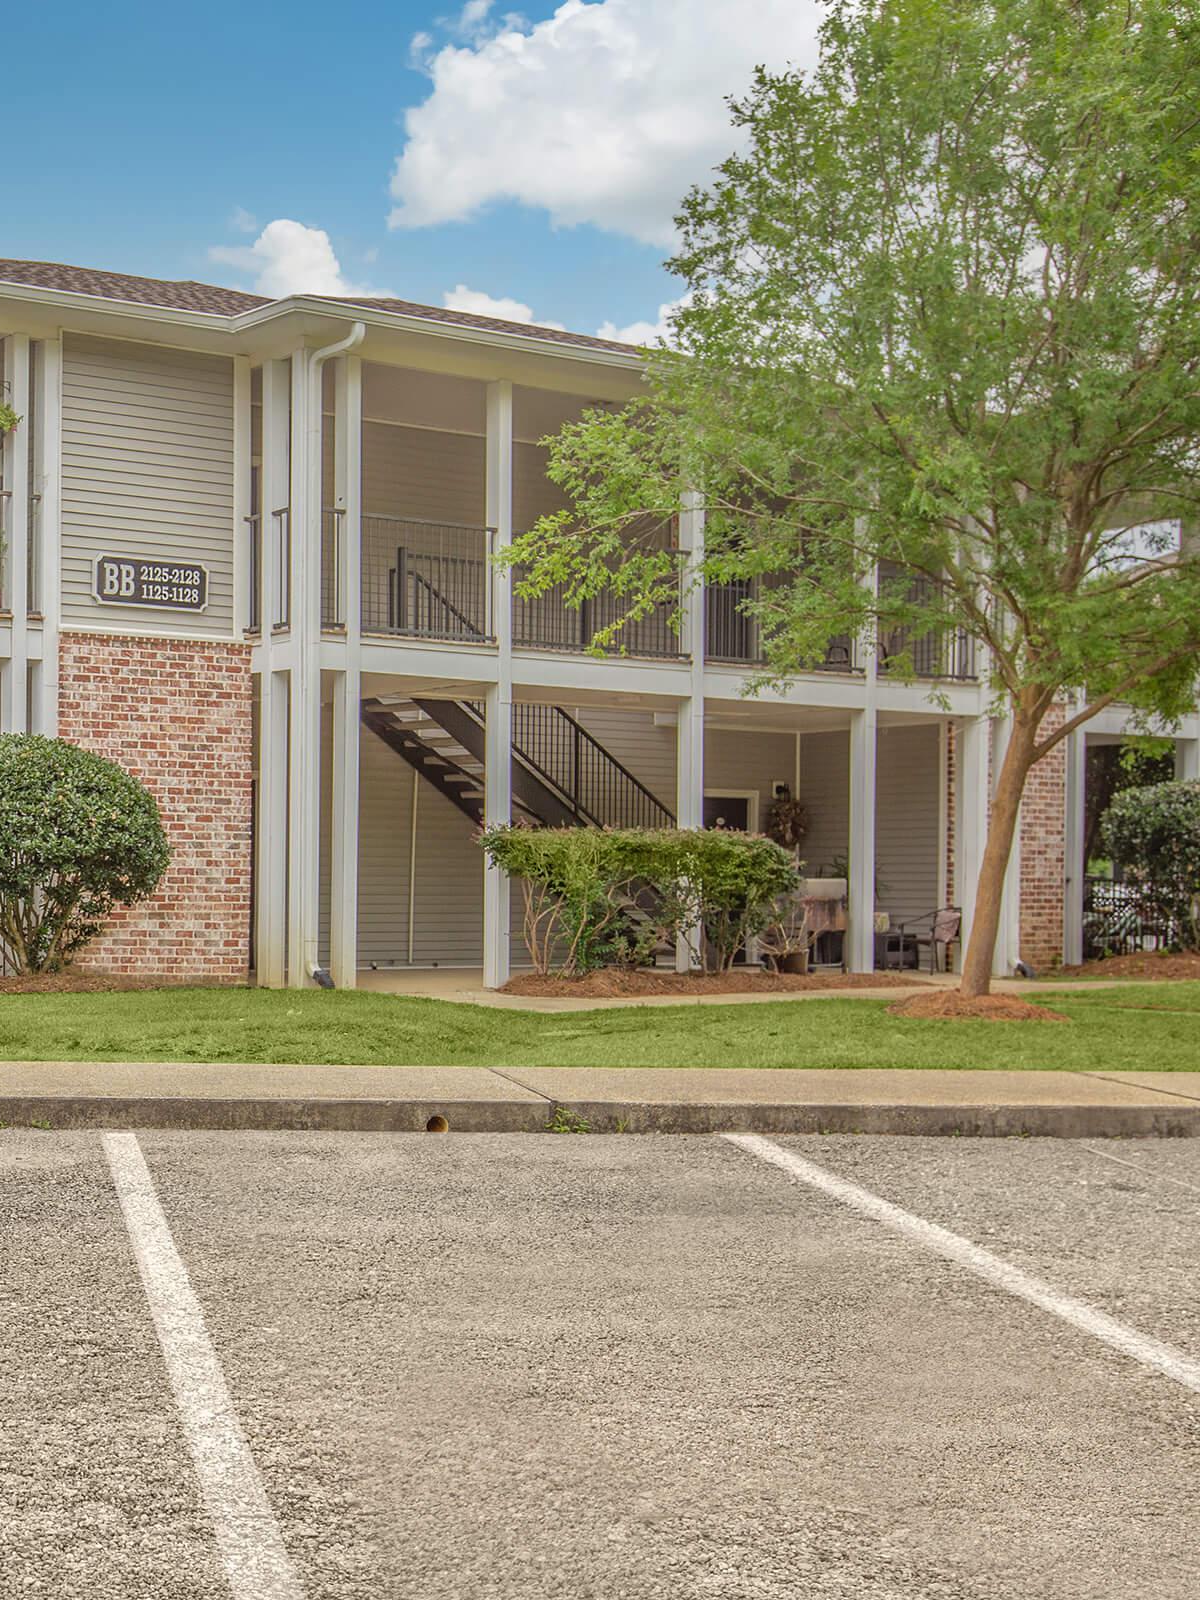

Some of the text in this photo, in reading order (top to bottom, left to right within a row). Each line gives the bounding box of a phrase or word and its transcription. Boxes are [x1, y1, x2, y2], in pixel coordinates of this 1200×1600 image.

[103, 562, 135, 596] BB
[140, 566, 200, 585] 2125-2128
[141, 584, 199, 603] 1125-1128
